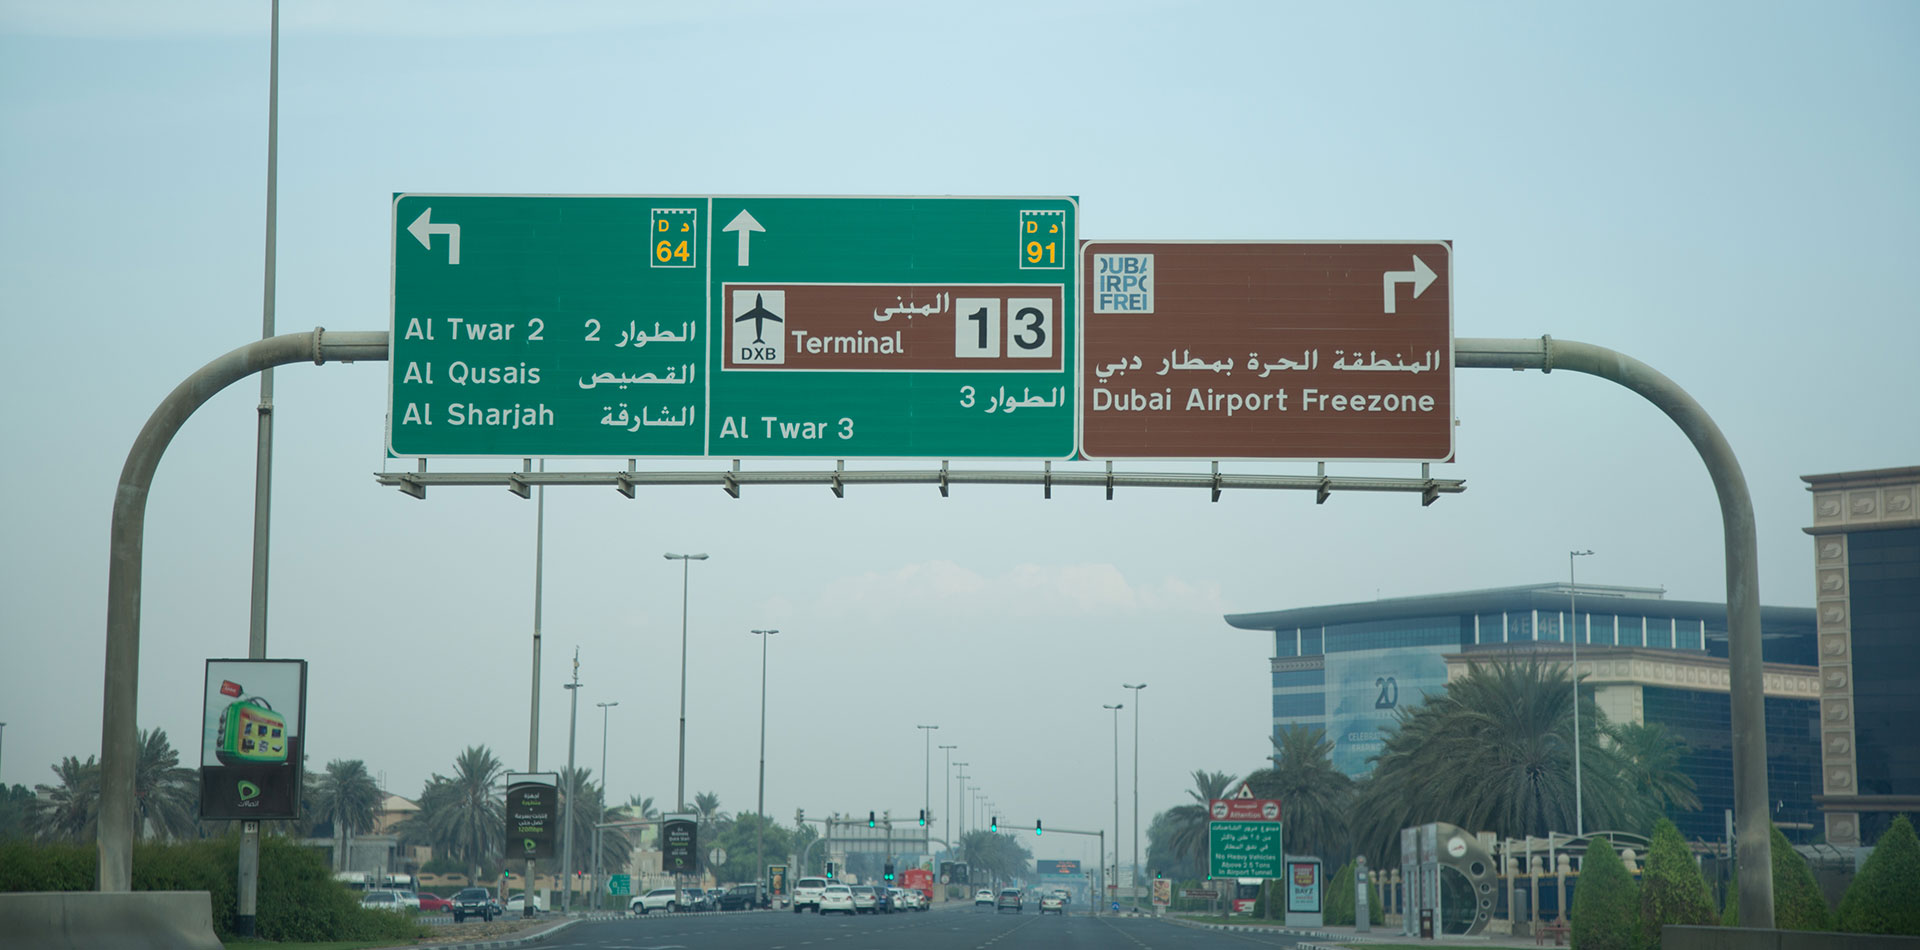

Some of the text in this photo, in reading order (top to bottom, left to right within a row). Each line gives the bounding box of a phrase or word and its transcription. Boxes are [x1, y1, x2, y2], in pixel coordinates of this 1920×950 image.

[658, 219, 669, 232] D
[680, 222, 690, 233] د
[1027, 221, 1038, 234] D
[1049, 223, 1058, 234] د
[656, 240, 690, 262] 64
[1026, 241, 1056, 264] 91
[873, 292, 950, 322] المبنى
[404, 318, 545, 341] Al Twar 2
[584, 318, 696, 348] الطوار 2
[968, 307, 1046, 350] 1 3
[741, 347, 776, 361] DXB
[791, 330, 904, 354] Terminal
[403, 361, 541, 386] Al Qusais
[578, 363, 695, 390] القصيص
[1095, 349, 1440, 384] المنطقة الحرة بمطار دبي
[959, 385, 1065, 414] الطوار 3
[1093, 388, 1435, 417] Dubai Airport Freezone
[402, 403, 554, 430] Al Sharjah
[600, 403, 695, 432] الشارقة
[719, 417, 854, 440] Al Twar 3
[1375, 677, 1399, 710] 20
